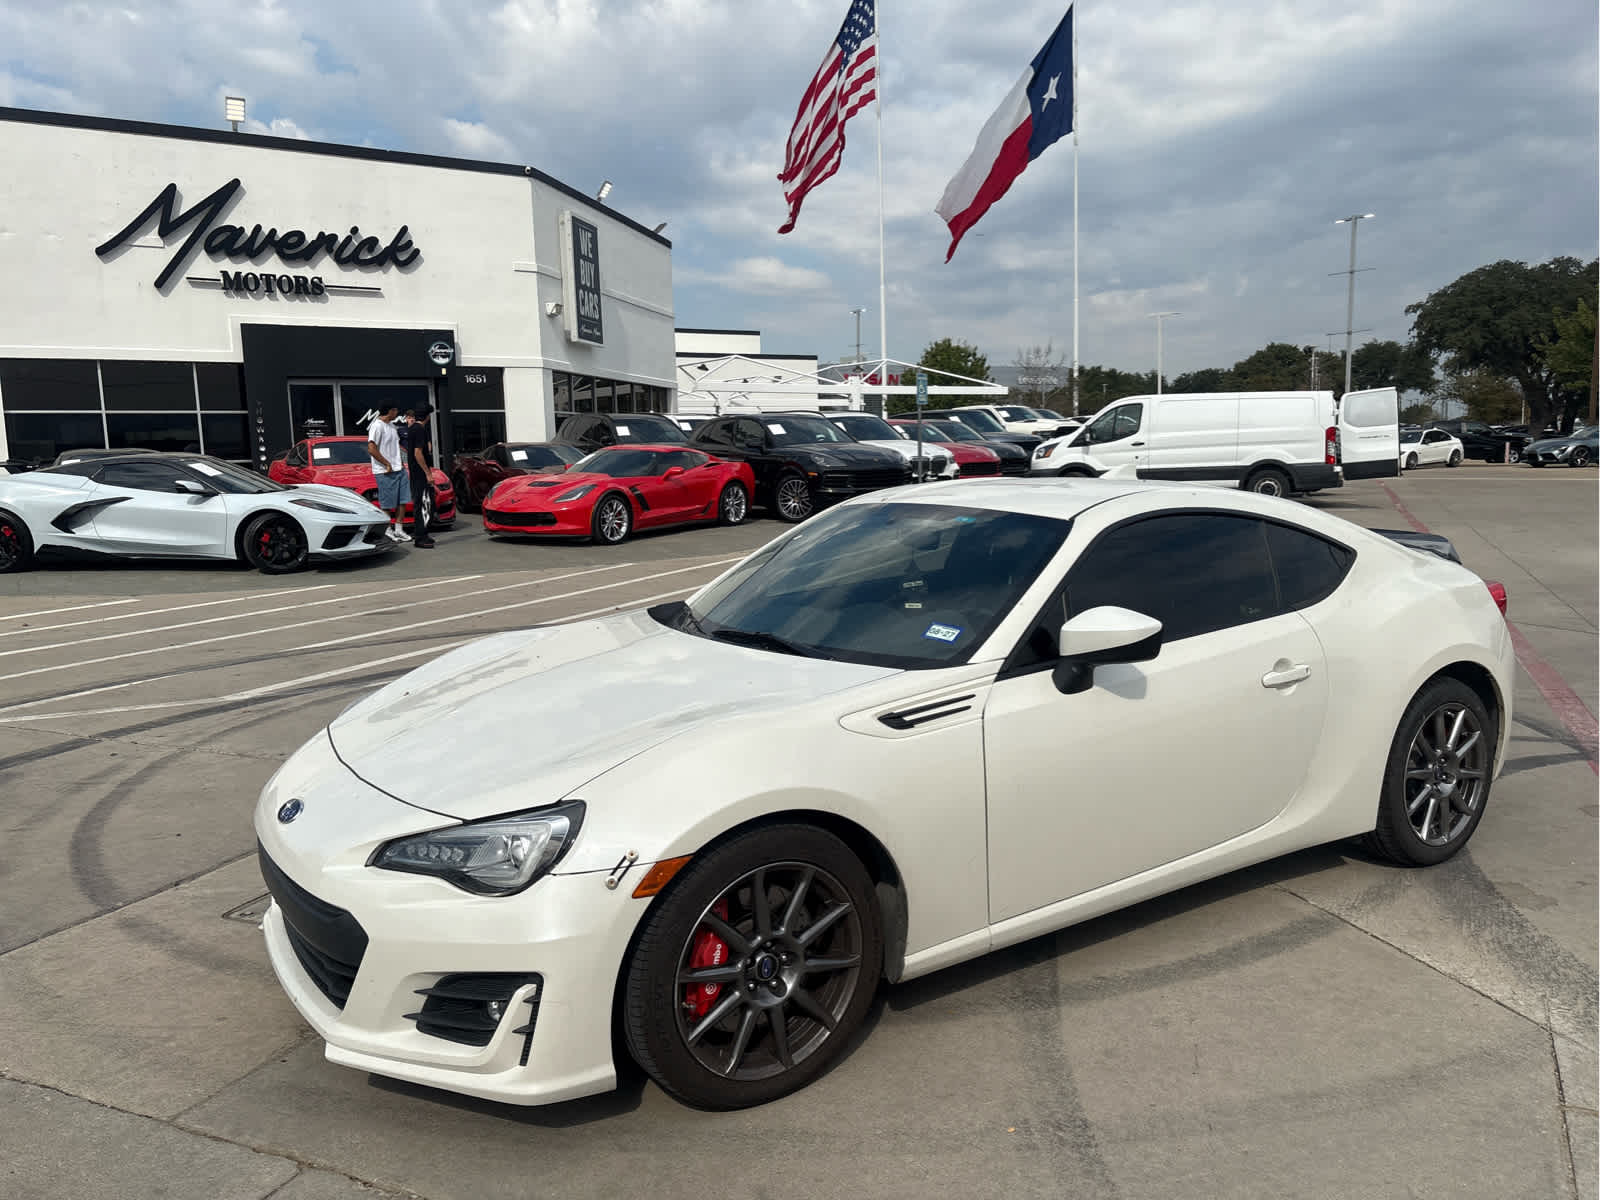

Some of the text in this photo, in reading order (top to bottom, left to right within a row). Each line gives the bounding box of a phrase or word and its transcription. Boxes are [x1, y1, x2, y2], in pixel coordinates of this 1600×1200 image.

[95, 178, 421, 289] Maverick
[579, 227, 593, 259] WE
[219, 270, 325, 296] MOTORS
[579, 258, 595, 289] BUY
[579, 289, 600, 320] CARS
[464, 374, 487, 384] 1651
[713, 943, 722, 965] mbo
